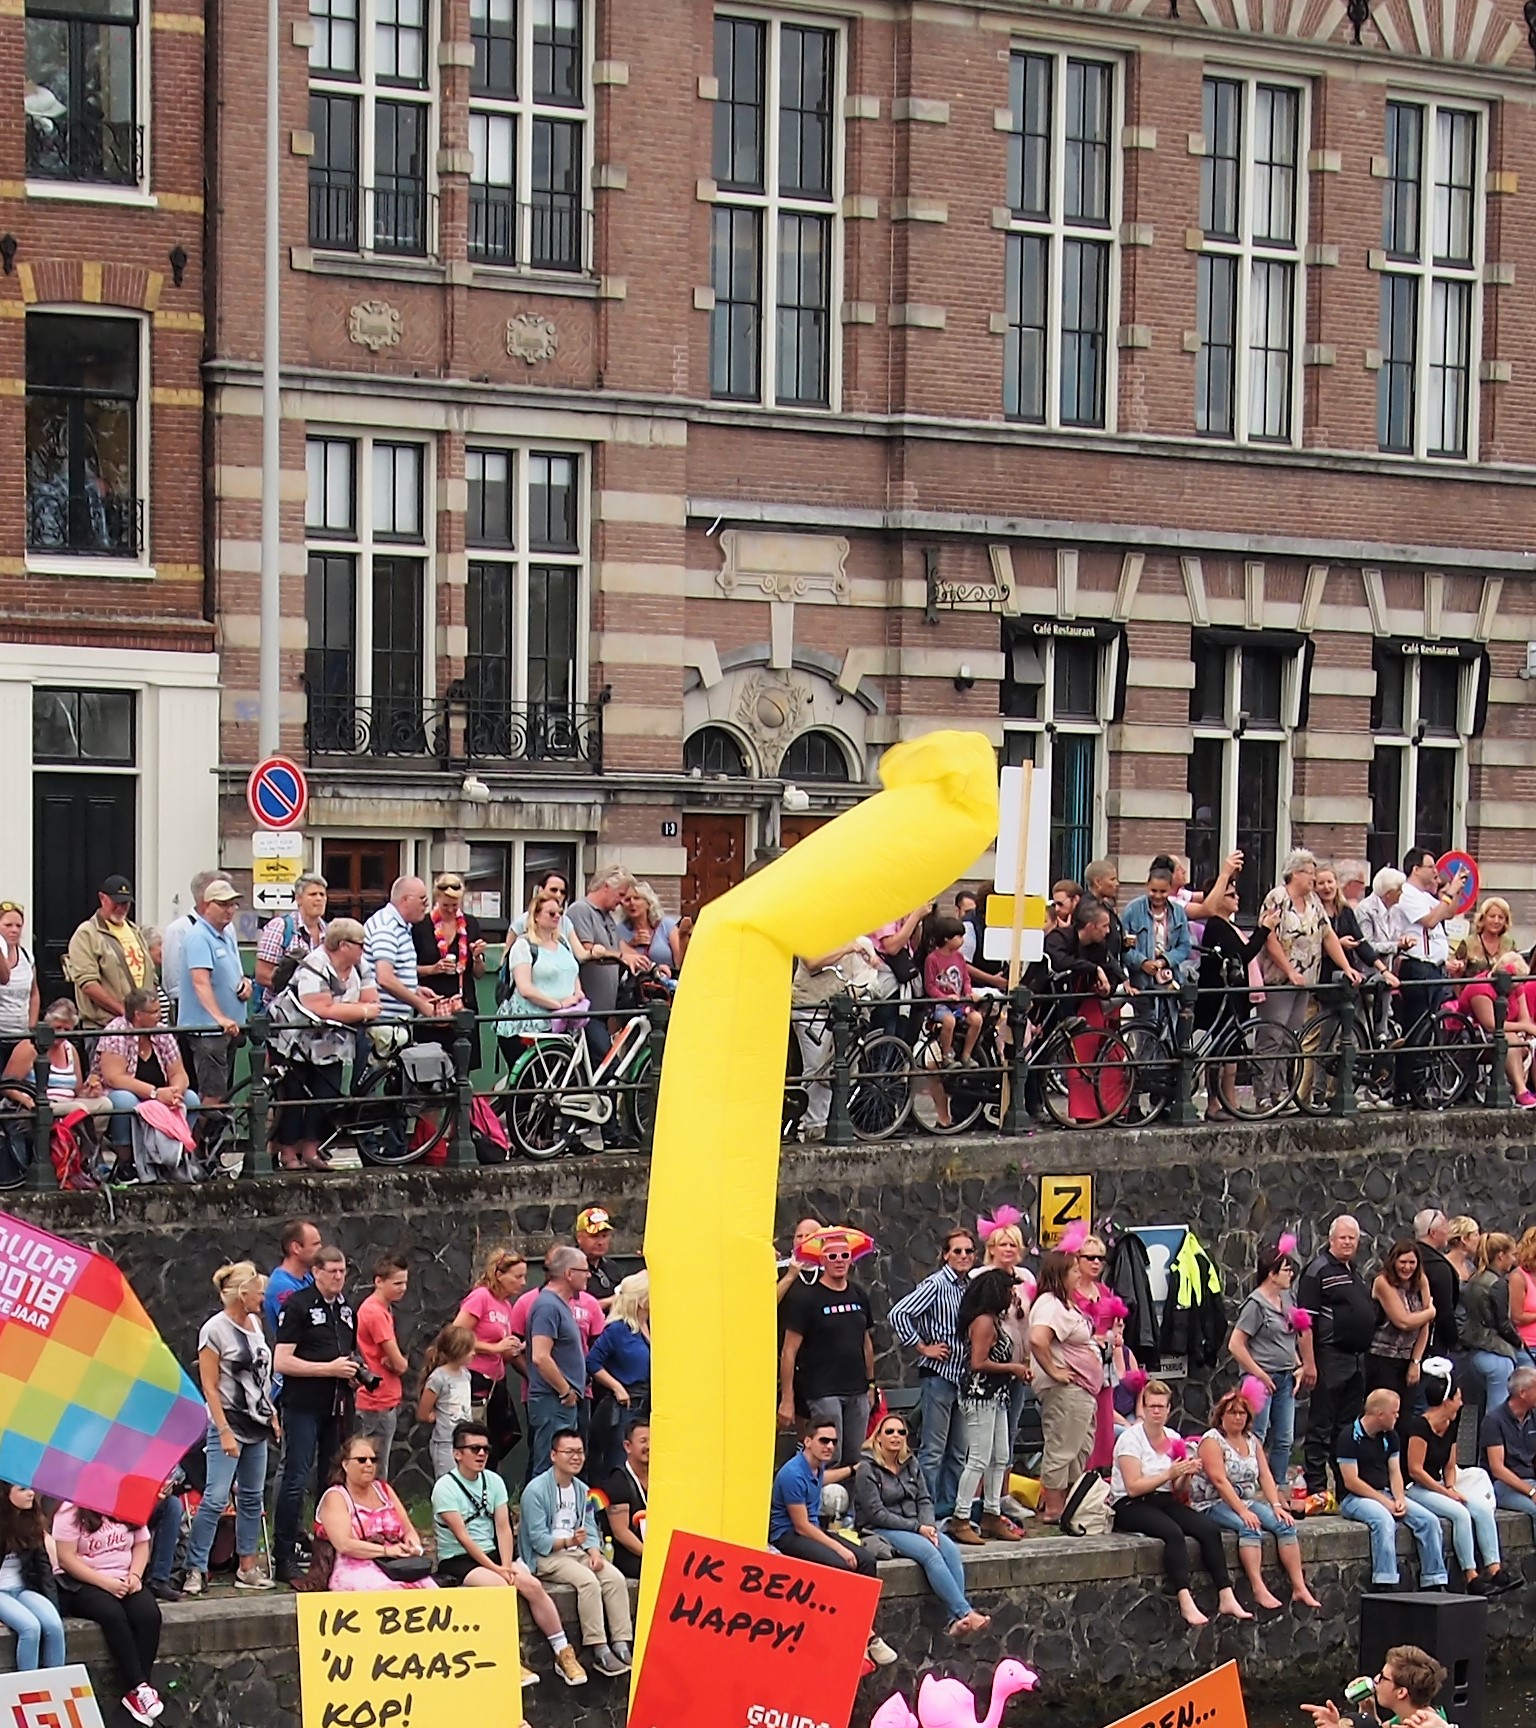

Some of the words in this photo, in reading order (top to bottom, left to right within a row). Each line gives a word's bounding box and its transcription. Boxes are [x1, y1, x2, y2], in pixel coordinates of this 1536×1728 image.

[1033, 623, 1052, 635] Café
[1053, 625, 1096, 637] Restaurant
[1421, 644, 1460, 656] Restaurant
[1053, 1186, 1082, 1226] Z
[10, 1304, 51, 1331] JAAR
[682, 1551, 725, 1583] IK
[739, 1565, 837, 1615] BEN...
[319, 1608, 361, 1637] IK
[375, 1604, 480, 1635] BEN...
[668, 1592, 805, 1653] HAPPY!
[371, 1650, 497, 1681] KAAS-
